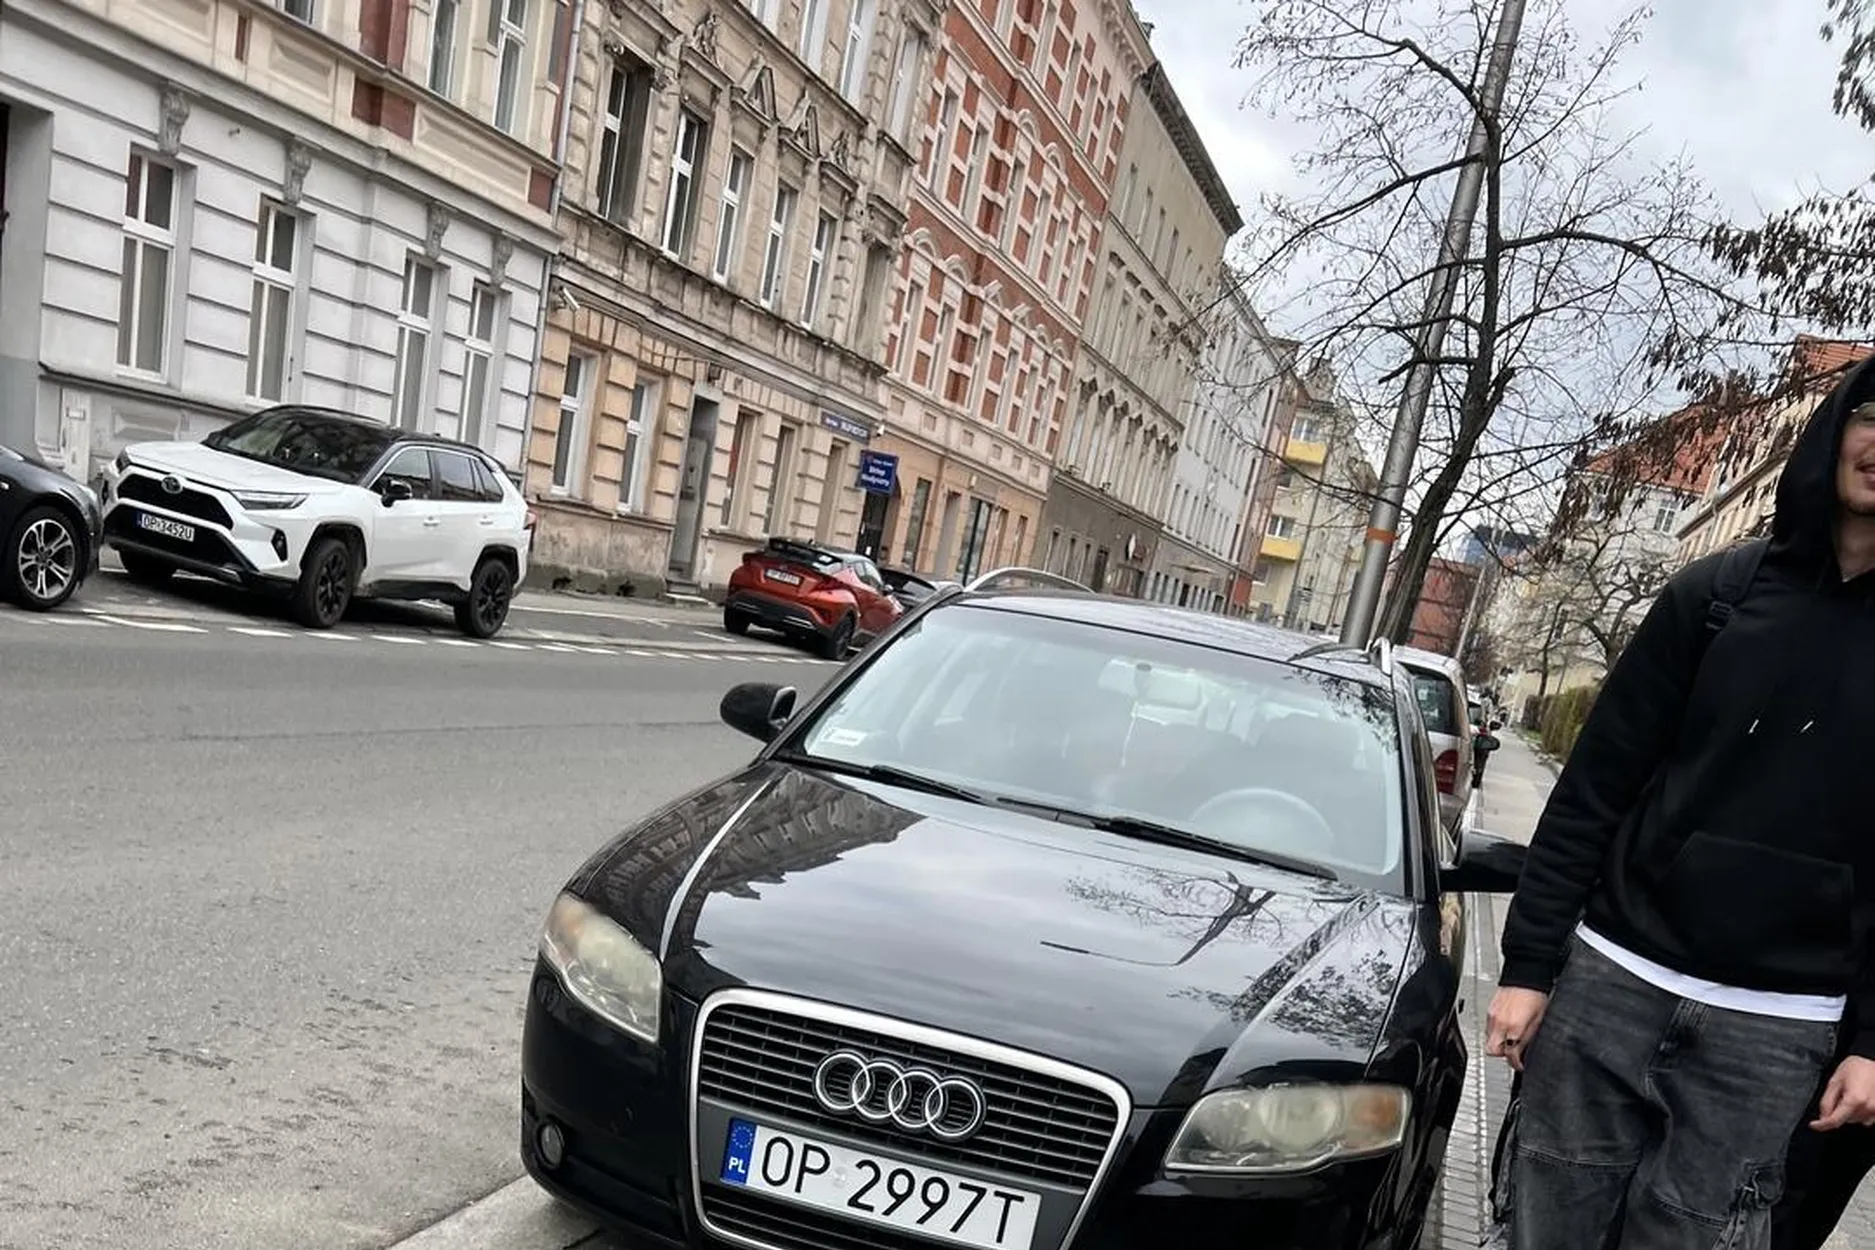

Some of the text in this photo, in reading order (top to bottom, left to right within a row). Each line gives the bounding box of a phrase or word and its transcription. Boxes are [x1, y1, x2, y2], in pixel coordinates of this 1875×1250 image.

[728, 1156, 747, 1174] PL
[761, 1135, 1026, 1245] OP 2997T
